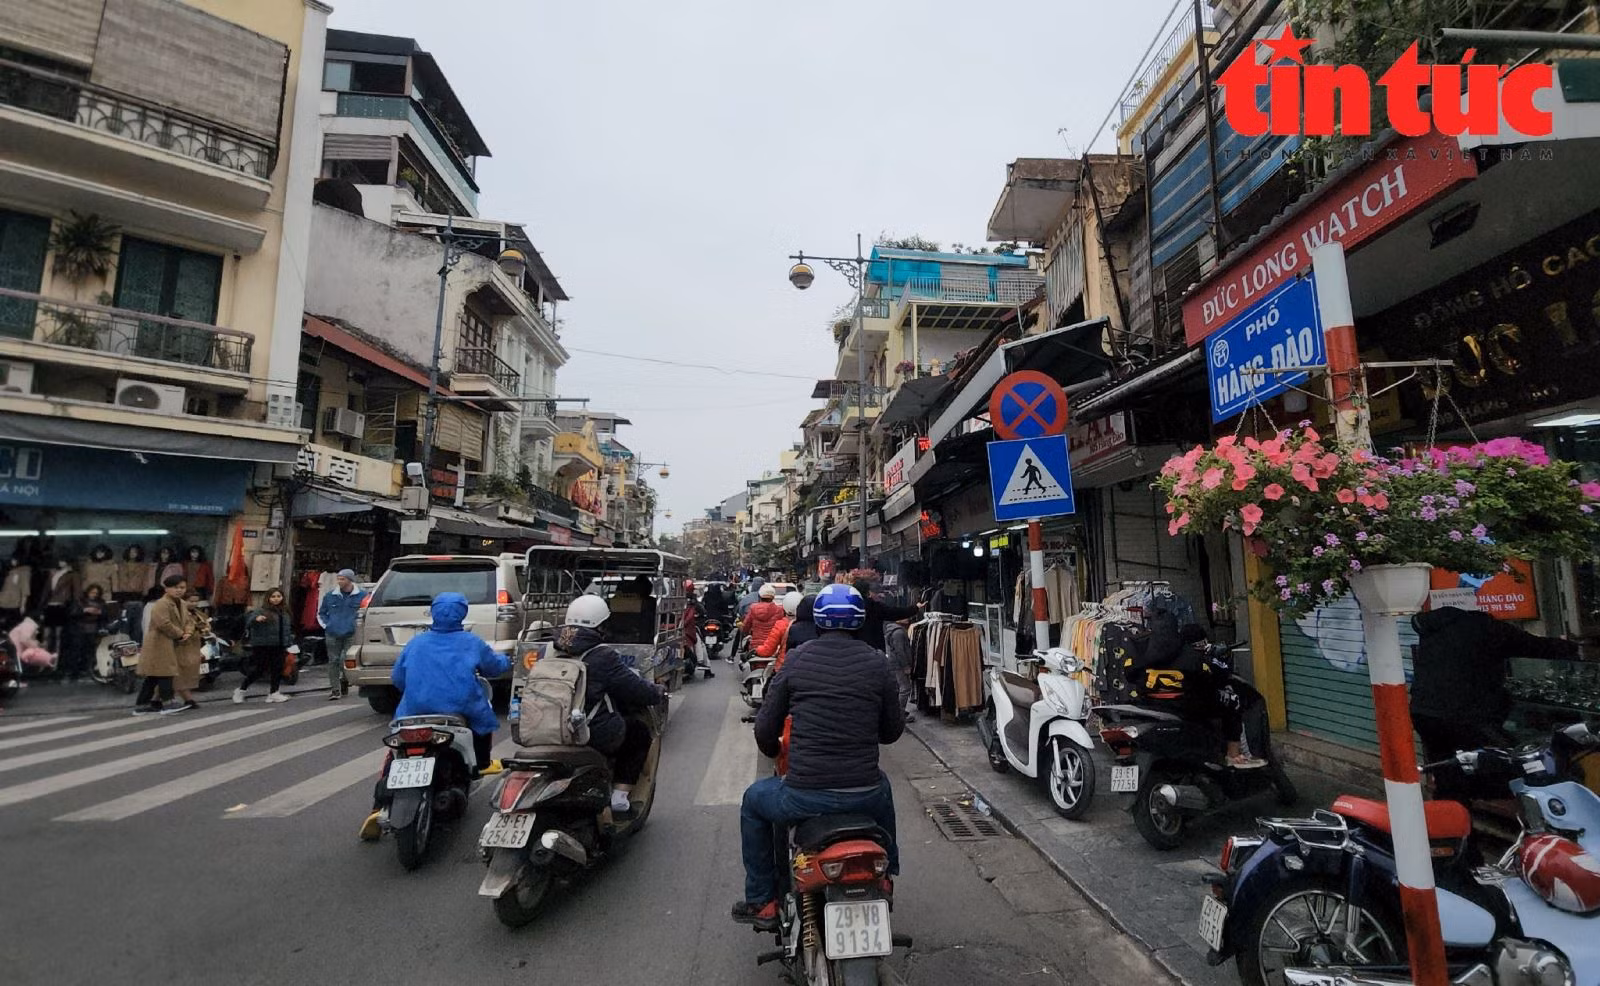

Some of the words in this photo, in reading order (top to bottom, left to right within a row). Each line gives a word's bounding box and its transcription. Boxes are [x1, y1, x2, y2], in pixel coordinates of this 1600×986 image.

[1242, 242, 1299, 299] LONG
[1301, 165, 1408, 256] WATCH
[1245, 298, 1280, 341] PHỐ
[1217, 355, 1265, 406] HÀNG
[1271, 326, 1314, 378] ĐÀO
[835, 927, 883, 955] 9134
